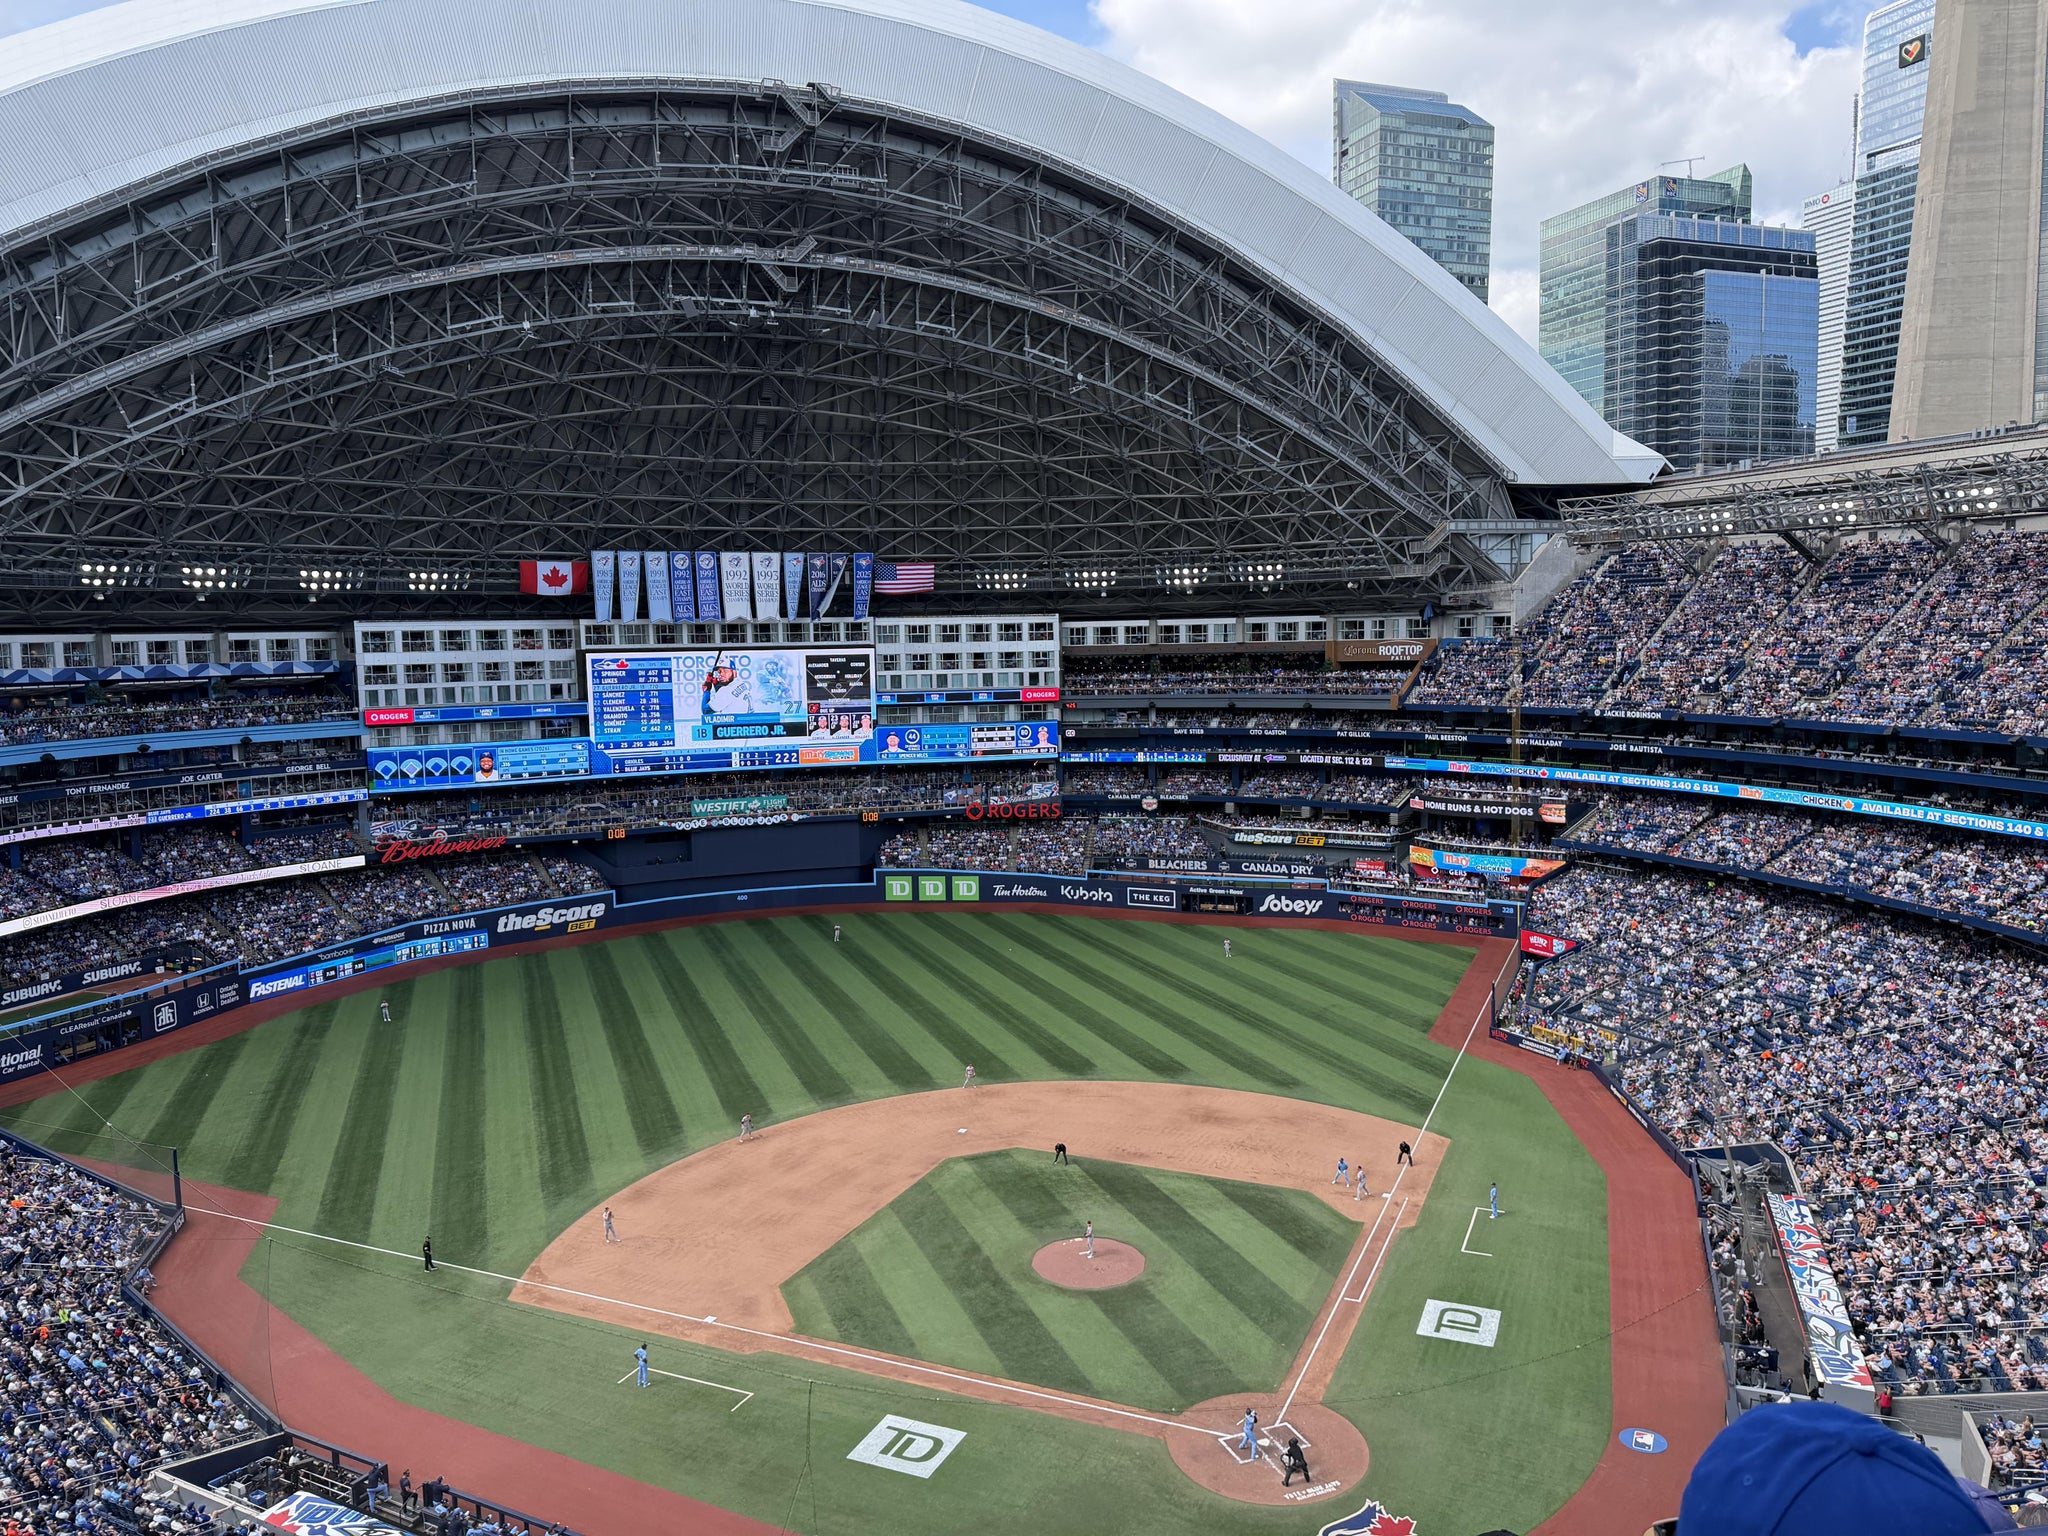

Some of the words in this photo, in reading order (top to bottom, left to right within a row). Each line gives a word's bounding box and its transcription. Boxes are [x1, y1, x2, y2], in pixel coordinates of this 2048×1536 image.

[1804, 199, 1820, 208] BMO
[726, 571, 748, 580] 1992
[757, 571, 779, 580] 1993
[1344, 645, 1377, 656] Corona
[1379, 645, 1424, 655] ROOFTOP
[784, 701, 802, 714] 27
[704, 715, 735, 724] VLADIMIR
[1604, 710, 1625, 718] JACKIE
[1627, 711, 1661, 719] ROBINSON
[697, 728, 708, 738] 1B
[717, 725, 768, 737] GUERRERO
[770, 724, 787, 736] JR.
[1529, 739, 1562, 747] HALLADAY
[1630, 746, 1663, 754] BAUTISTA
[776, 754, 781, 762] 2
[784, 753, 789, 762] 2
[792, 753, 797, 762] 2
[1218, 754, 1253, 762] EXCLUSIVELY
[1254, 754, 1261, 762] AT
[1332, 756, 1344, 764] SEC.
[286, 765, 312, 773] GEORGE
[180, 775, 195, 783] JOE
[197, 773, 223, 782] CARTER
[1449, 762, 1470, 773] Mary
[1504, 767, 1538, 776] CHICKEN
[1554, 770, 1606, 782] AVAILABLE
[1609, 774, 1621, 782] AT
[1622, 776, 1670, 788] SECTIONS
[1672, 781, 1691, 790] 140
[1693, 783, 1700, 791] &
[1702, 784, 1719, 793] 511
[66, 788, 87, 796] TONY
[90, 782, 130, 793] FERNANDEZ
[693, 801, 747, 812] WESTJET
[988, 803, 1061, 818] ROGERS
[1425, 801, 1446, 810] HOME
[1448, 802, 1472, 812] RUNS
[1473, 805, 1481, 813] &
[1483, 805, 1503, 814] HOT
[1505, 807, 1533, 816] DOGS
[1739, 788, 1762, 802] Mary
[1802, 795, 1842, 808] CHICKEN
[1861, 803, 1925, 819] AVAILABLE
[1926, 811, 1942, 821] AT
[1943, 812, 2004, 831] SECTIONS
[2007, 822, 2031, 834] 140
[2034, 826, 2043, 836] &
[158, 813, 185, 822] GUERRERO
[676, 819, 707, 830] VOTE
[722, 817, 753, 825] BLUE
[757, 814, 788, 825] JAYS
[1234, 833, 1292, 844] theScore
[1296, 837, 1325, 845] BET
[375, 834, 507, 863] Budweiser
[299, 860, 342, 873] SLOANE
[1148, 859, 1207, 870] BLEACHERS
[1443, 854, 1470, 868] Mary
[1242, 863, 1289, 873] CANADA
[1291, 865, 1313, 874] DRY.
[889, 882, 909, 896] TD
[922, 882, 943, 896] TD
[956, 882, 976, 896] TD
[993, 885, 1011, 897] Tim
[1011, 885, 1047, 897] Hortons
[1061, 885, 1113, 902] Kubota
[100, 893, 142, 909] SLOANE
[1133, 893, 1150, 901] THE
[1153, 894, 1170, 902] KEG
[1260, 894, 1323, 915] Sobeys
[1410, 902, 1436, 910] ROGERS
[1464, 907, 1492, 915] ROGERS
[497, 903, 605, 933] theScore
[1358, 916, 1383, 924] ROGERS
[423, 923, 450, 935] PIZZA
[452, 920, 476, 930] NOVA
[570, 921, 592, 931] BET
[1410, 921, 1436, 929] ROGERS
[1464, 926, 1492, 934] ROGERS
[1529, 936, 1548, 946] HEINZ
[82, 961, 142, 985] SUBWAY
[220, 983, 239, 993] Ontario
[250, 974, 305, 998] FASTENAL
[0, 980, 62, 1005] SUBWAY
[220, 990, 236, 999] Honda
[221, 995, 239, 1006] Dealers
[193, 1005, 215, 1016] HONDA
[60, 1018, 101, 1035] CLEAResult
[101, 1010, 125, 1023] Canada
[1491, 1029, 1508, 1040] HEINZ
[2, 1066, 15, 1074] Car
[17, 1059, 40, 1072] Rental
[1434, 1308, 1482, 1334] TD
[879, 1426, 944, 1462] TD
